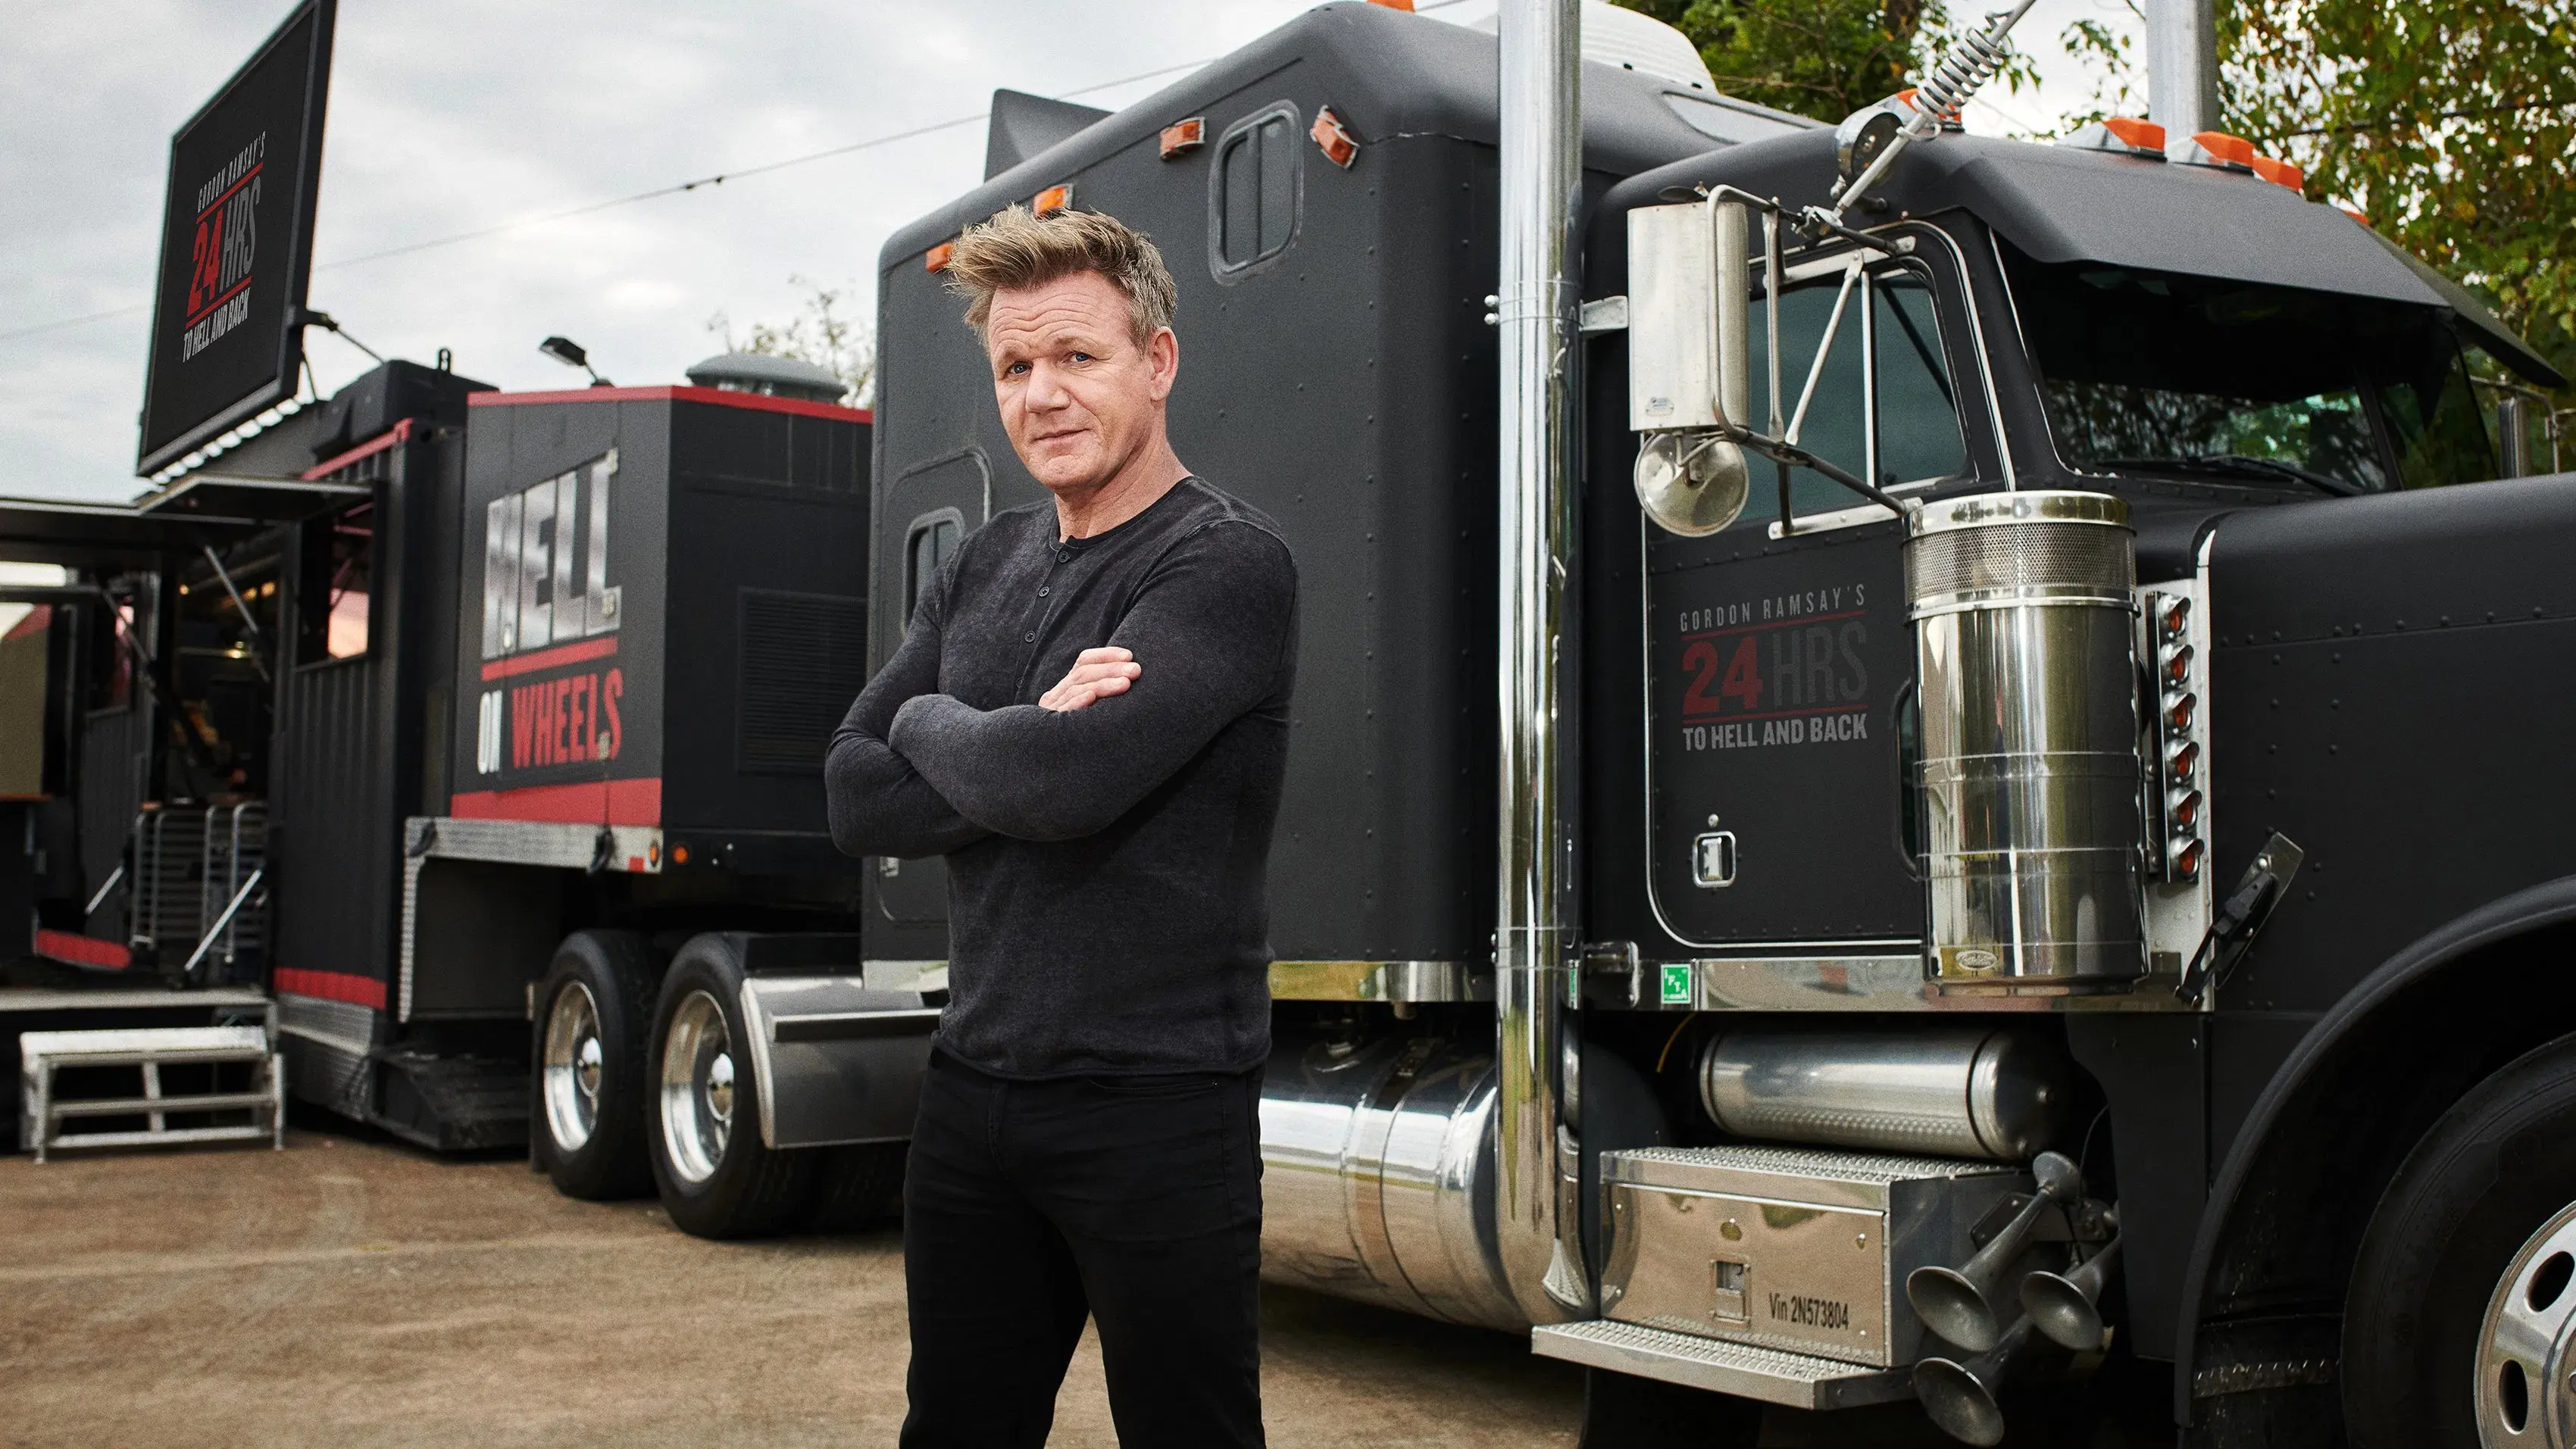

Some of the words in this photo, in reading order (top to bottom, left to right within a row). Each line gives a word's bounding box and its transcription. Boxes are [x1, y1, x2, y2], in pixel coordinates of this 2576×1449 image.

[198, 167, 226, 214] GORDON
[227, 130, 266, 187] RAMSAY'S
[183, 329, 193, 363] TO
[192, 316, 210, 356] HELL
[211, 304, 227, 343] AND
[227, 286, 250, 333] BACK
[482, 457, 622, 660] HELL
[1680, 602, 1751, 633] GORDON
[1762, 583, 1865, 620] RAMSAY'S
[512, 667, 623, 770] WHEELS
[1683, 726, 1706, 751] TO
[1711, 722, 1758, 749] HELL
[1762, 718, 1805, 745] AND
[1810, 713, 1868, 742] BACK
[1769, 1292, 1788, 1321] Vin
[1790, 1295, 1849, 1331] 2N573804
